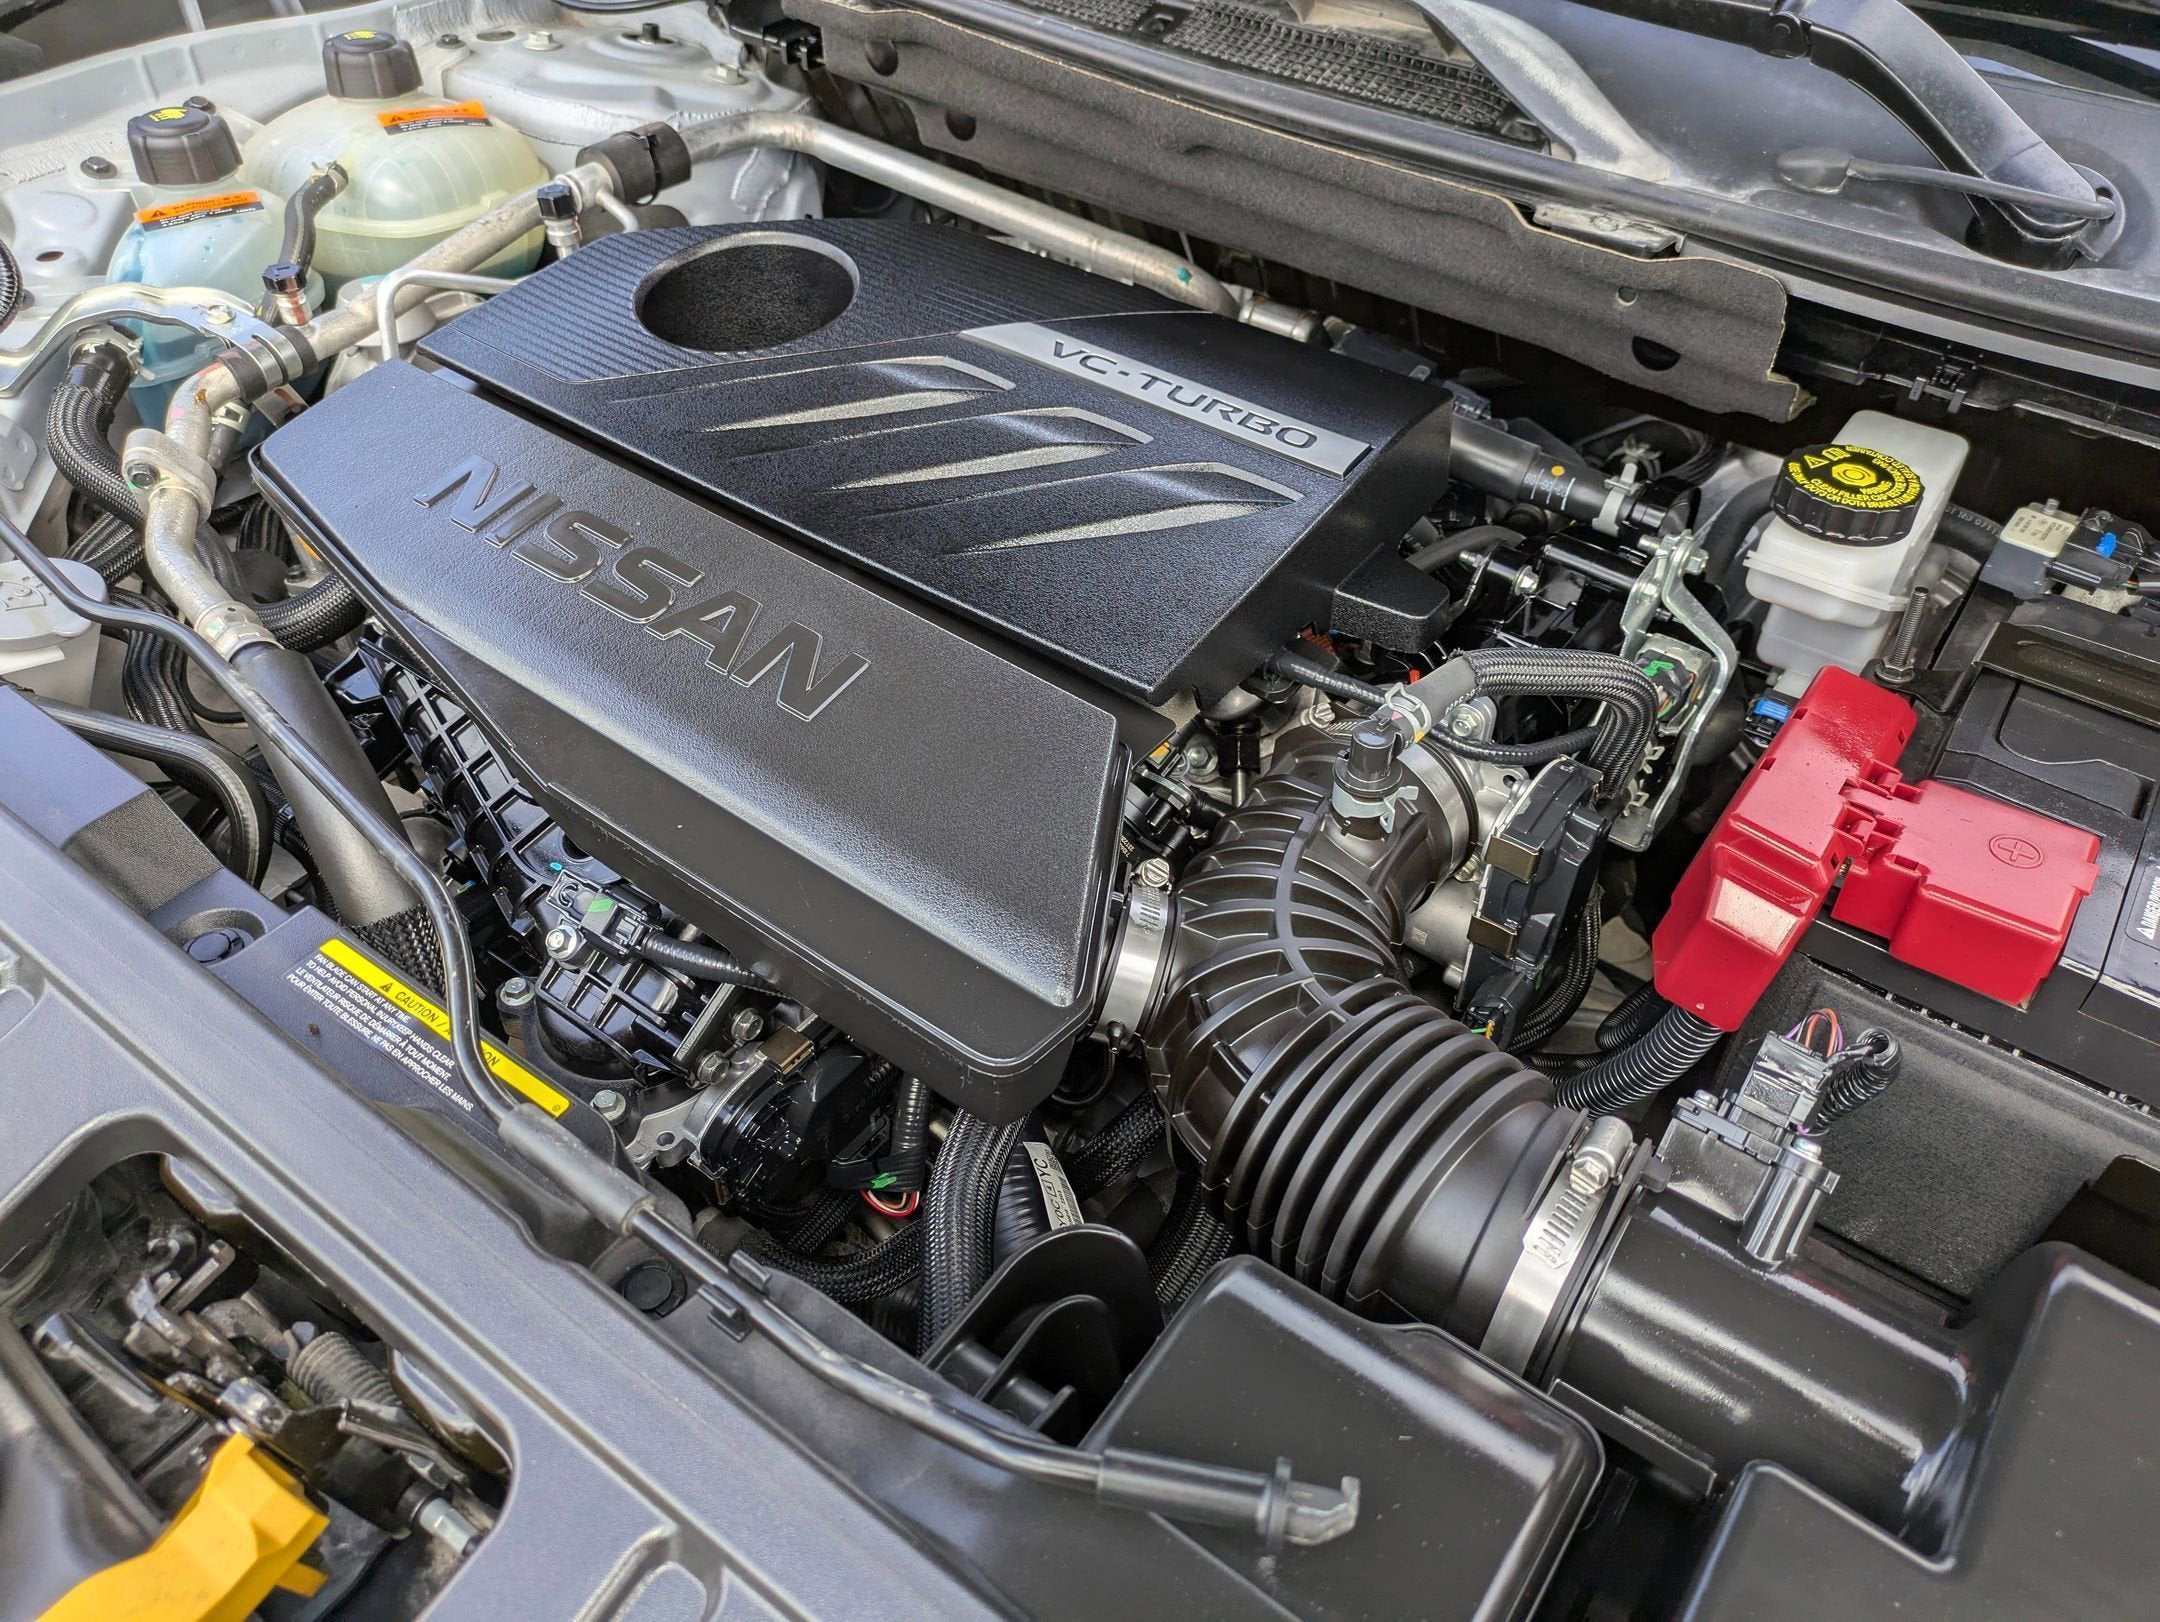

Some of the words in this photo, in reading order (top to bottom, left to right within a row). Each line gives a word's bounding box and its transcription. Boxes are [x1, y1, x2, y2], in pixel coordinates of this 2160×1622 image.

[1053, 339, 1317, 450] VC-TURBO
[1809, 478, 1838, 494] CLEAN
[1836, 490, 1871, 500] FILLER
[413, 454, 872, 722] NISSAN
[295, 967, 307, 975] LE
[303, 973, 341, 1000] VENTILATEUR
[337, 998, 363, 1016] RISQUE
[359, 1013, 372, 1022] DE
[368, 1018, 403, 1044] DÉMARRER
[398, 1039, 409, 1048] À
[405, 1046, 425, 1060] TOUT
[421, 1057, 452, 1080] MOMENT.
[306, 960, 317, 969] TO
[314, 966, 332, 978] HELP
[328, 977, 349, 991] AVOID
[345, 989, 378, 1012] PERSONAL
[409, 1034, 435, 1052] HANDS
[314, 954, 329, 964] FAN
[325, 962, 346, 976] BLADE
[344, 975, 359, 986] CAN
[356, 984, 378, 998] START
[374, 997, 385, 1005] AT
[382, 1002, 397, 1012] ANY
[394, 990, 439, 1023] CAUTION
[286, 974, 307, 988] POUR
[302, 984, 327, 1001] ÉVITER
[322, 1000, 344, 1015] TOUTE
[338, 1012, 374, 1037] BLESSURE,
[371, 1035, 383, 1043] NE
[379, 1040, 395, 1051] PAS
[391, 1049, 404, 1058] EN
[400, 1056, 442, 1086] APPROCHER
[438, 1084, 455, 1095] LES
[450, 1093, 474, 1112] MAINS.
